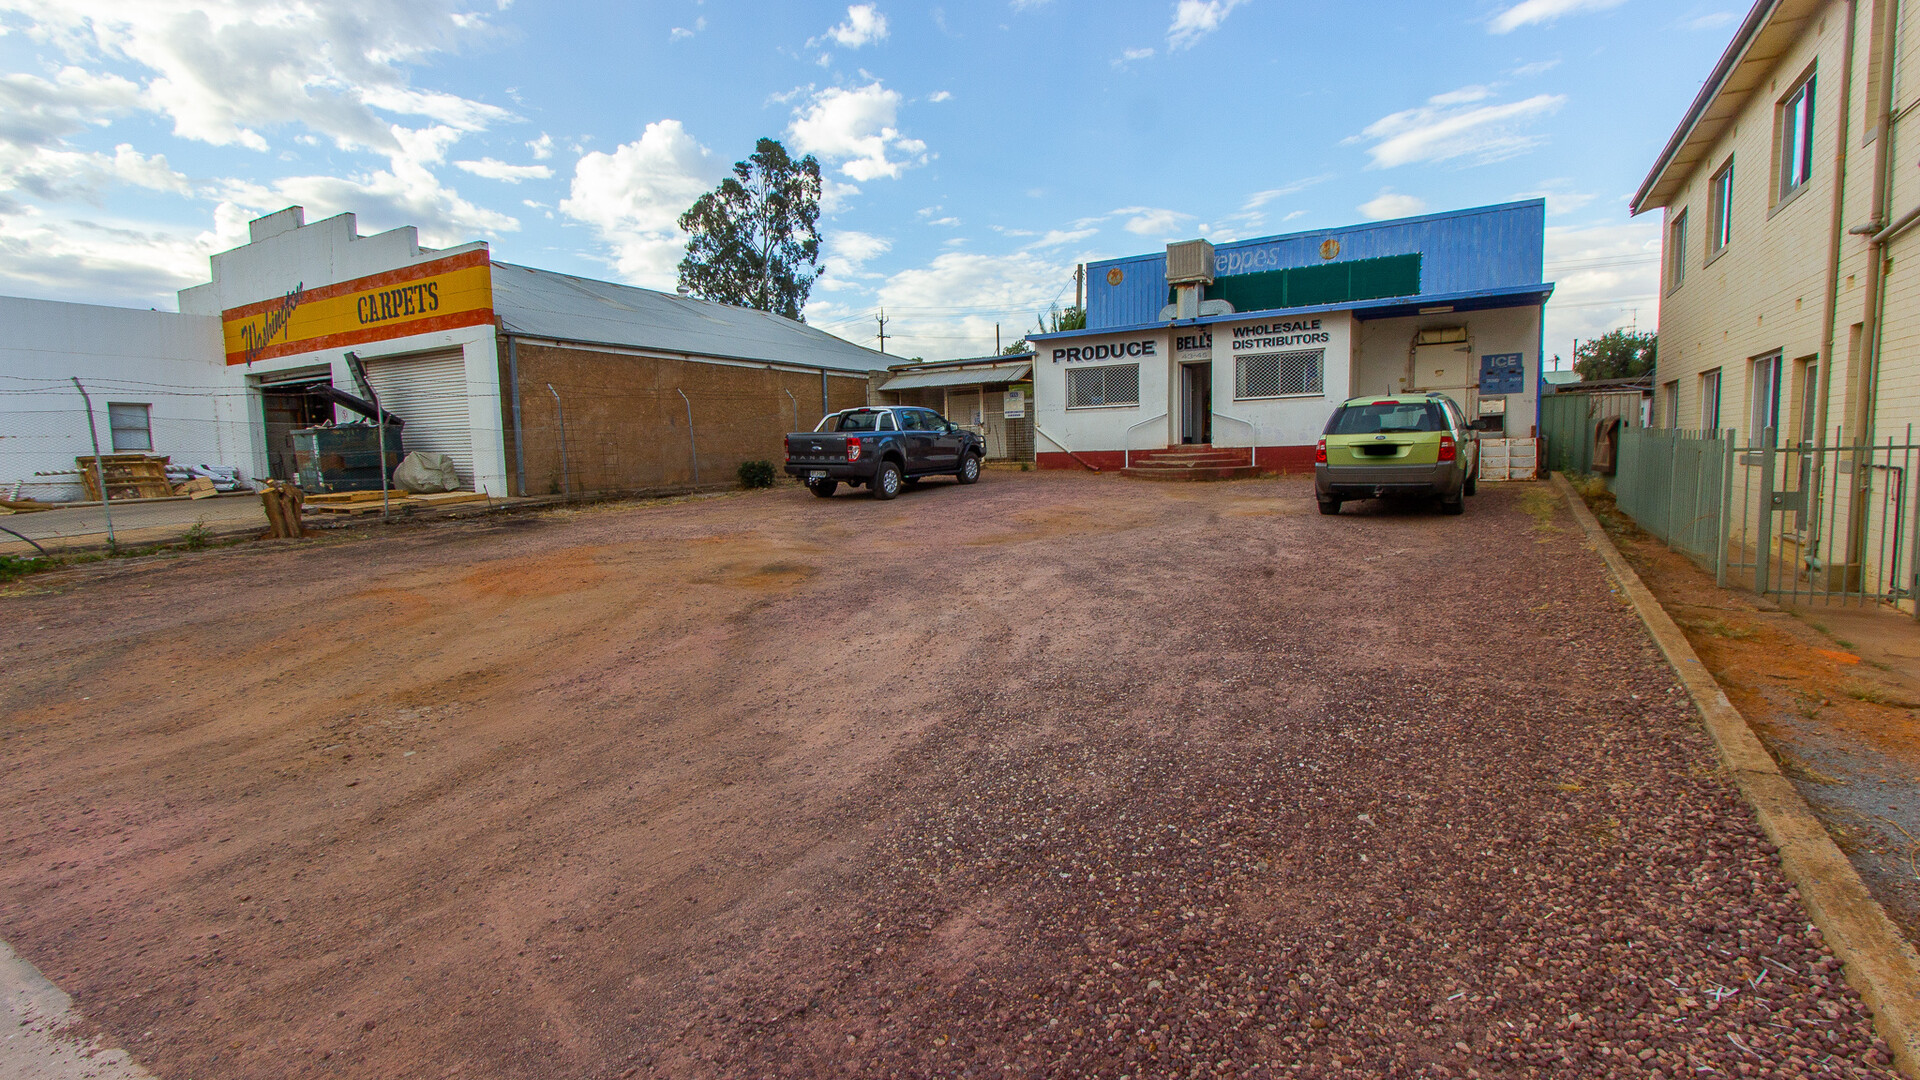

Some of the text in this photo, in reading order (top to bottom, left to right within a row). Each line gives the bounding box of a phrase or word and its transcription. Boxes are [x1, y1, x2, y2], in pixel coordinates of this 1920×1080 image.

[1213, 247, 1280, 276] eppes
[357, 281, 439, 325] CARPETS
[241, 281, 304, 368] Washington
[1232, 319, 1322, 338] WHOLESALE
[1052, 340, 1157, 364] PRODUCE
[1176, 331, 1213, 351] BELL'S
[1232, 332, 1329, 350] DISTRIBUTORS
[1491, 355, 1517, 367] ICE
